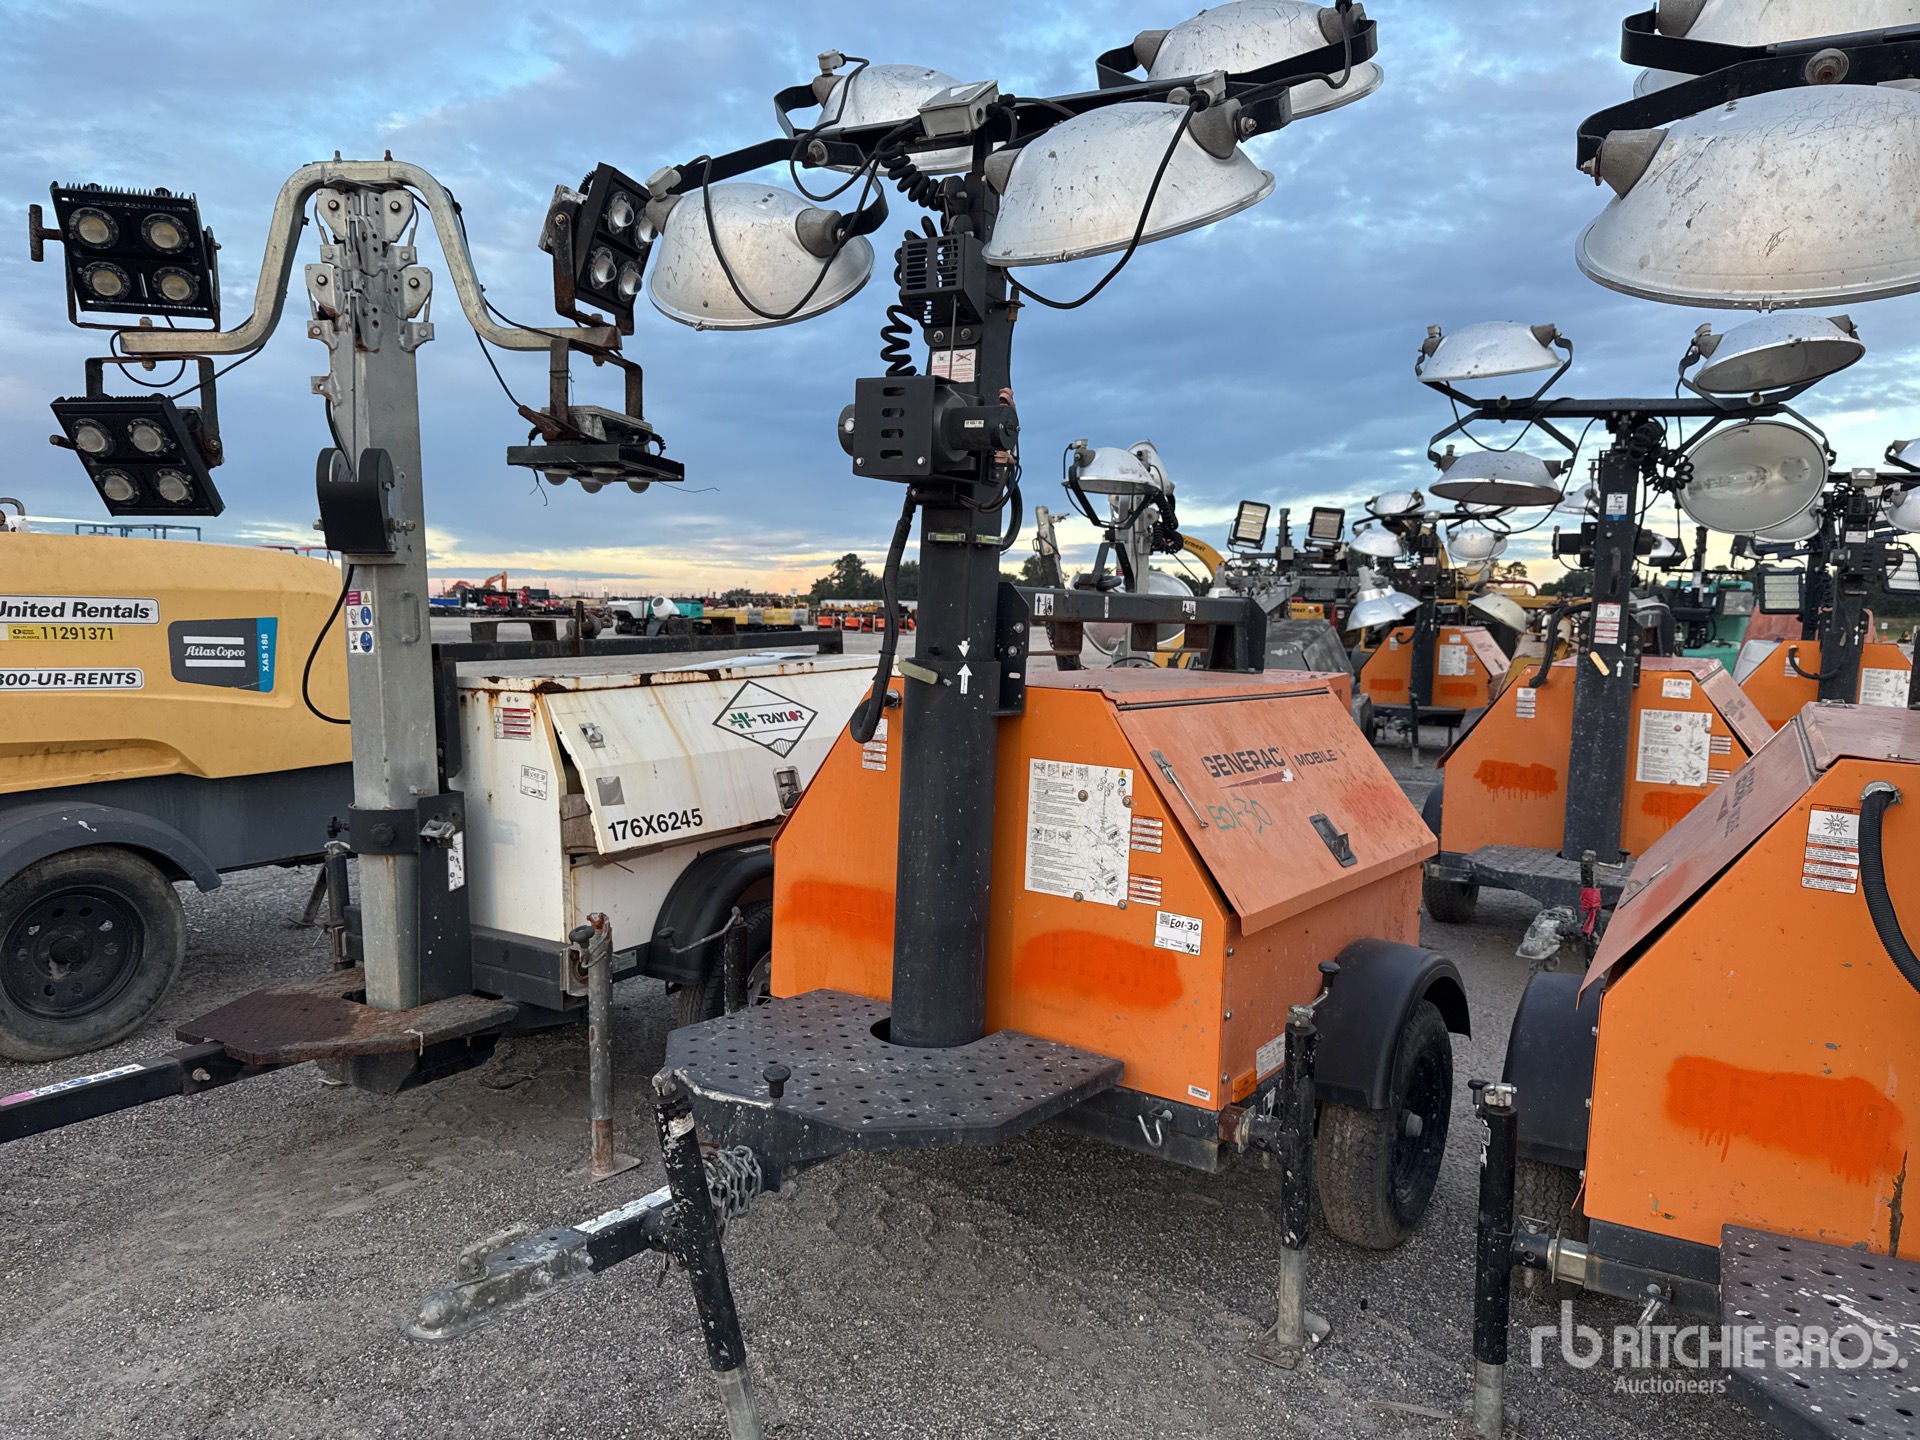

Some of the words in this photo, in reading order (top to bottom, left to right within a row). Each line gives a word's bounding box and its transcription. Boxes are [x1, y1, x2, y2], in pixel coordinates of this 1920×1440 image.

[72, 602, 150, 619] Rentals
[41, 626, 114, 640] 11291371
[185, 646, 216, 657] Atlas
[216, 646, 245, 658] Copco
[757, 710, 805, 725] TRAYLOR
[1201, 747, 1286, 778] GENERAC
[1294, 749, 1338, 767] MOBILE
[608, 808, 703, 841] 176X6245
[1170, 918, 1200, 931] E01-30
